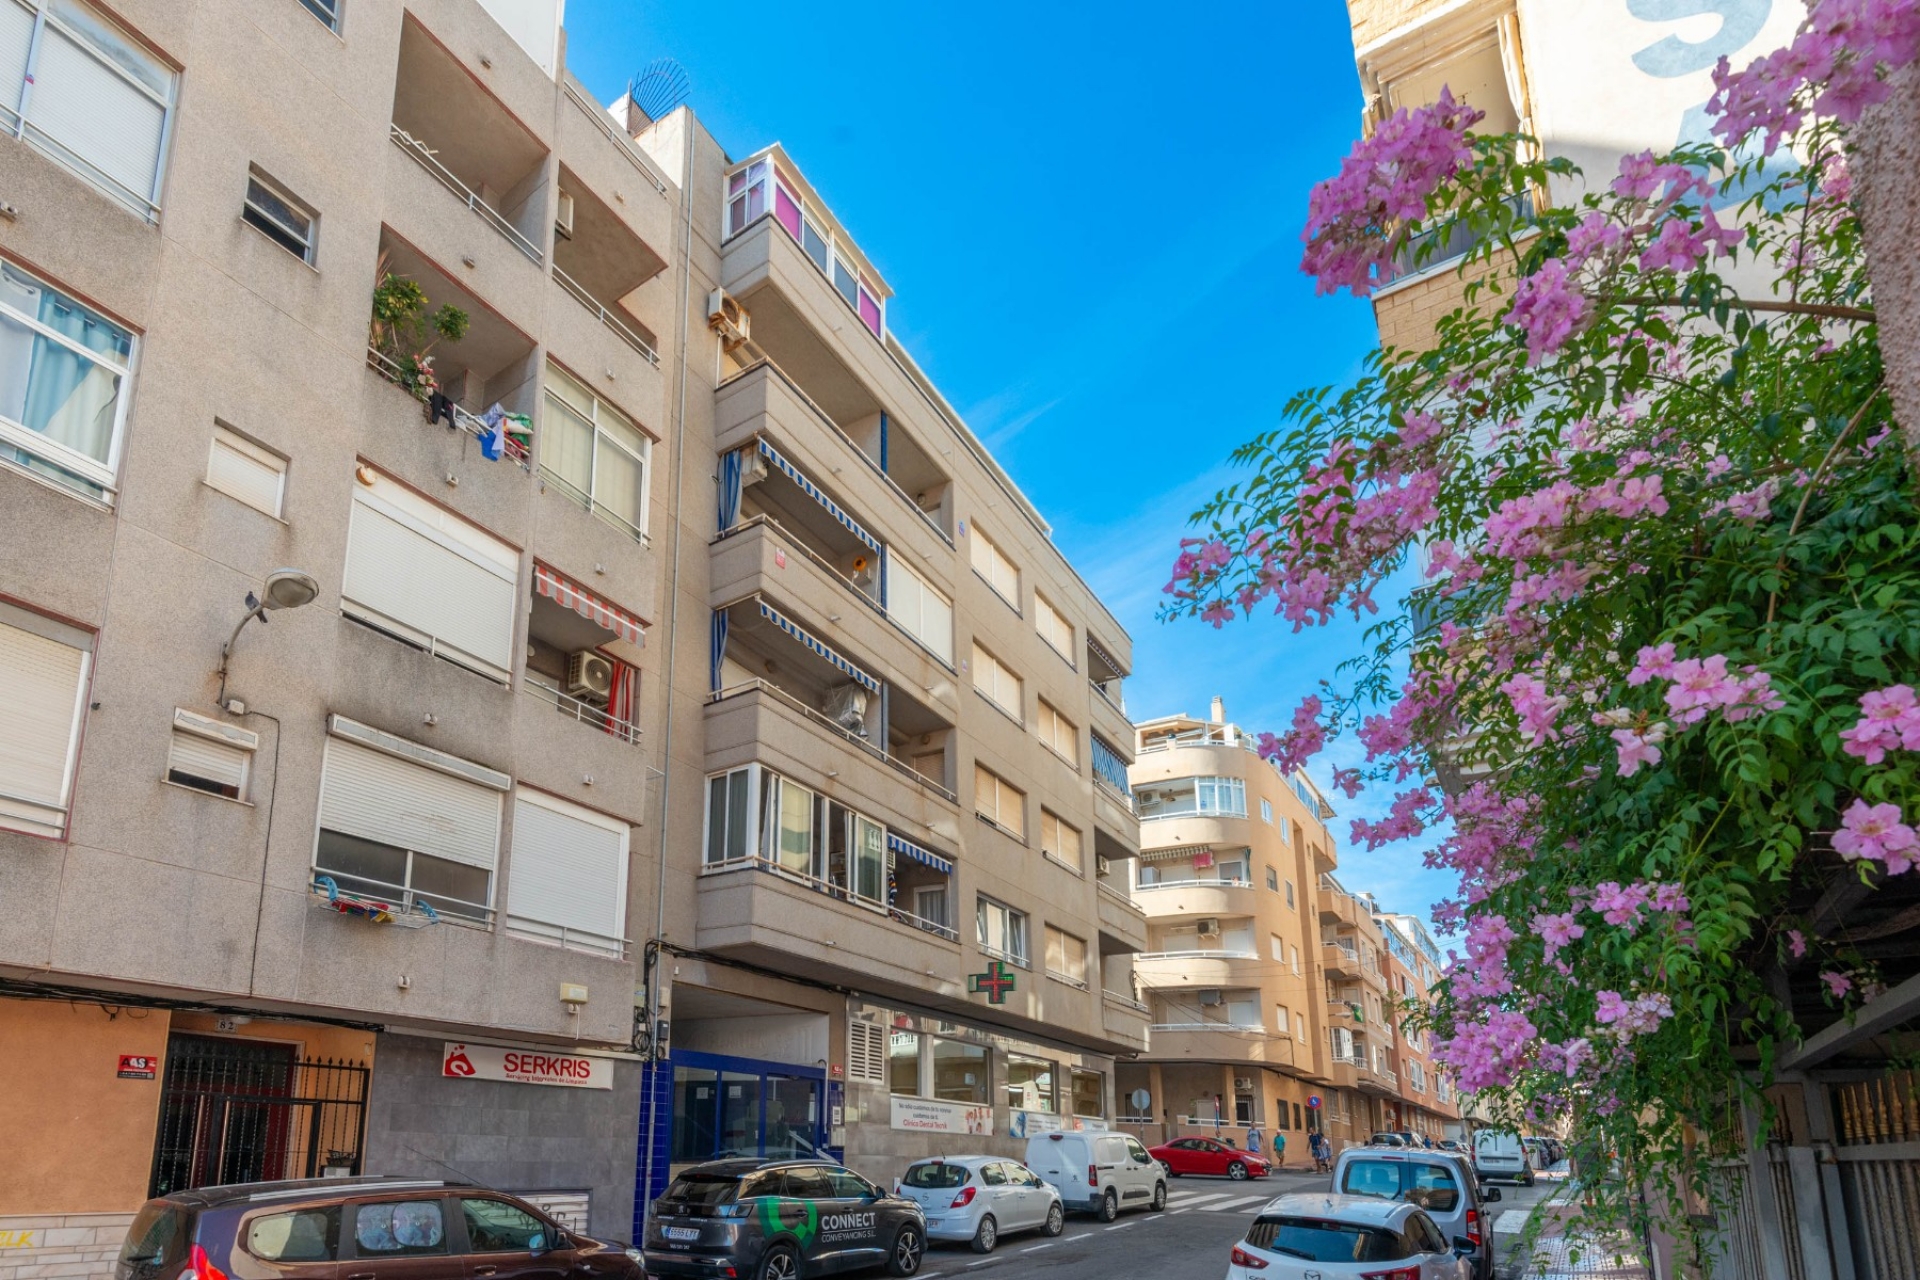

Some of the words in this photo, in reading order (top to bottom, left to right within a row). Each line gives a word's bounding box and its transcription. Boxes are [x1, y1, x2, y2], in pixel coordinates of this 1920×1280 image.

[219, 1021, 234, 1030] 82
[503, 1053, 590, 1078] SERKRIS
[821, 1212, 875, 1230] CONNECT
[822, 1231, 867, 1243] CONVEYANCING
